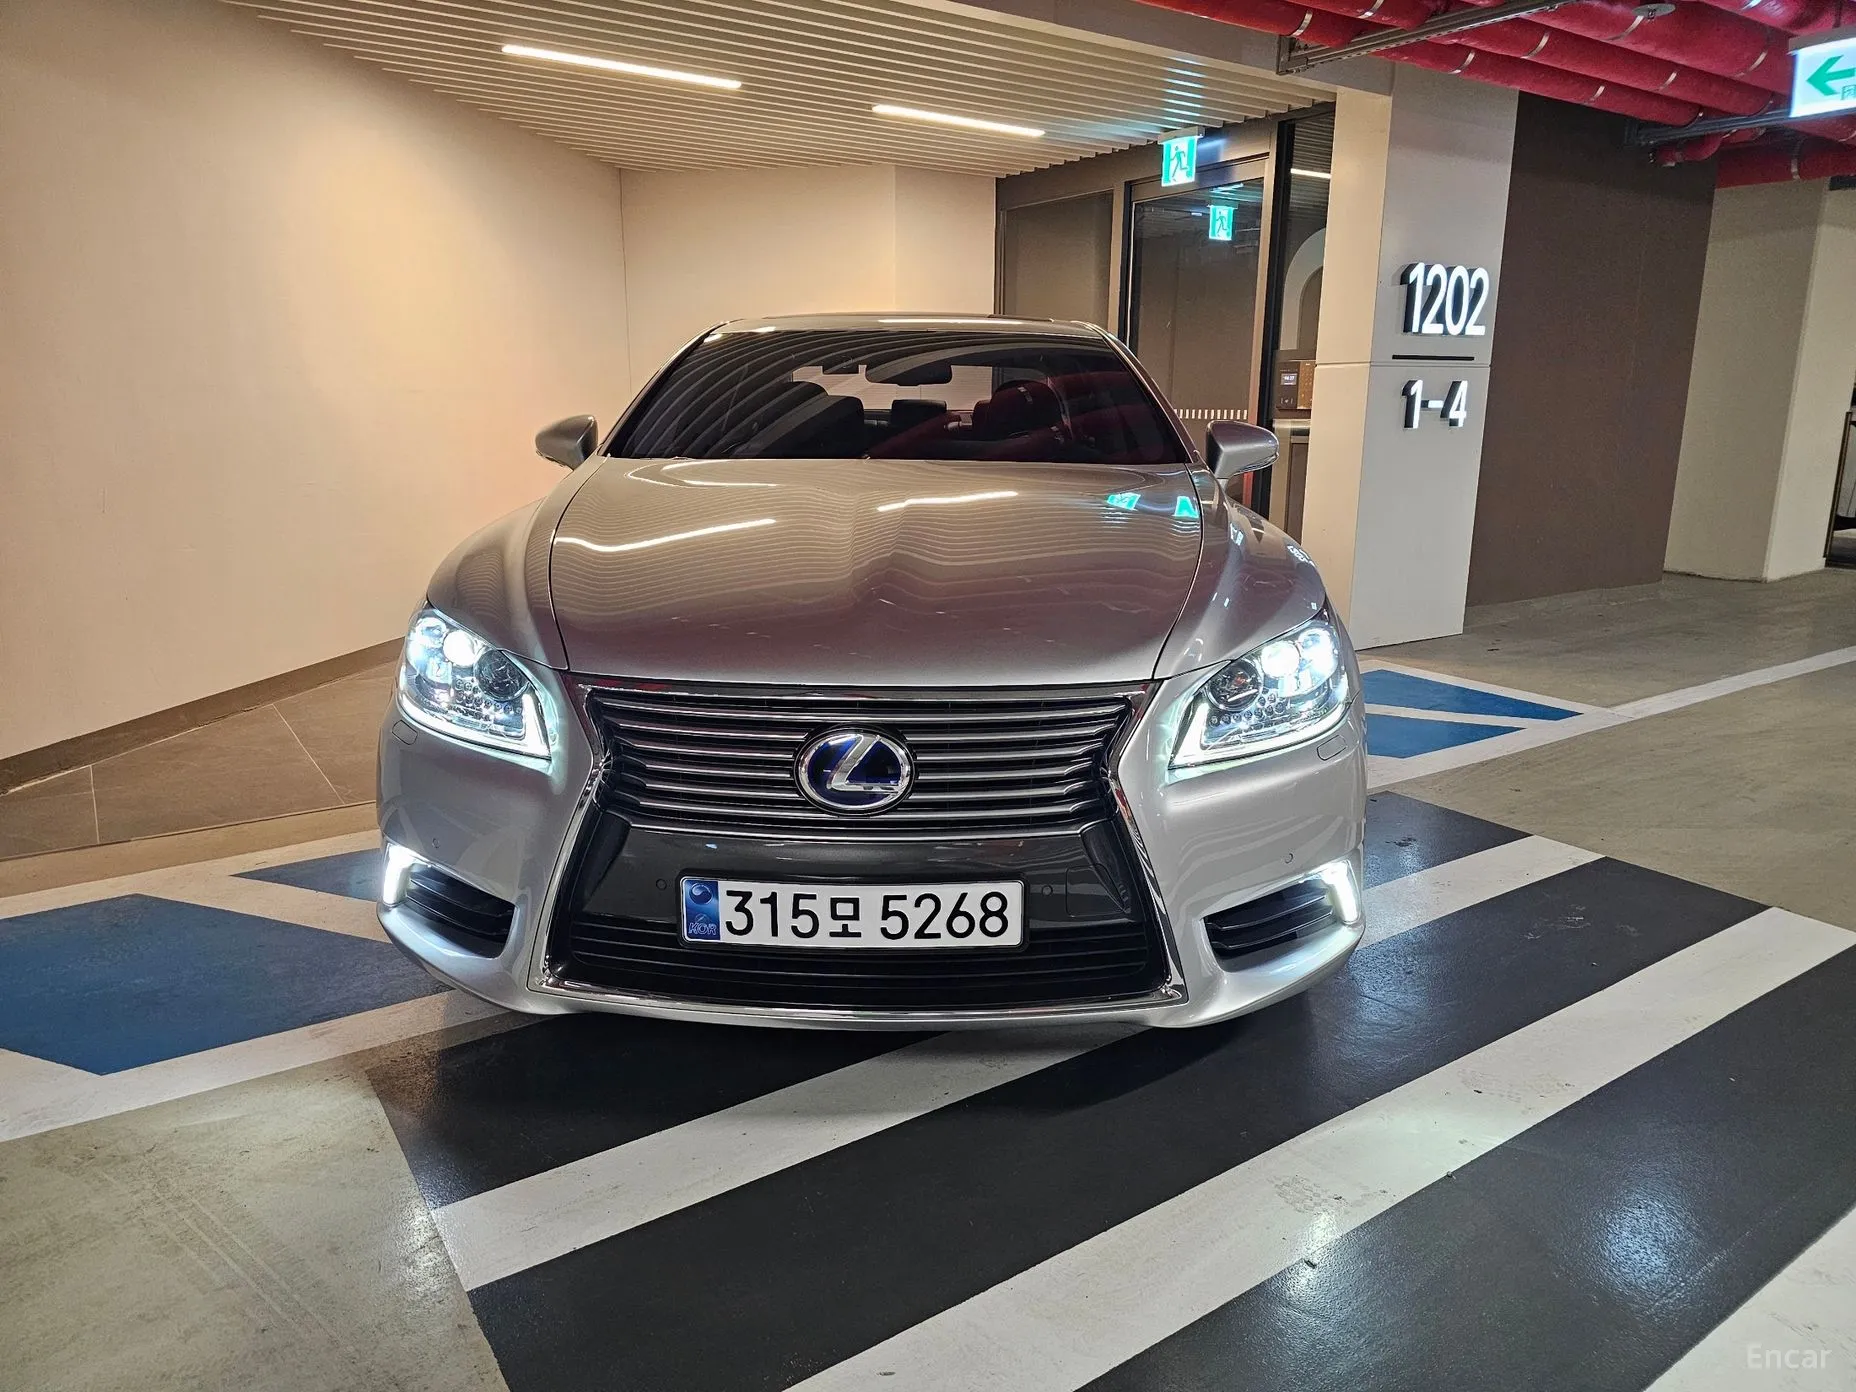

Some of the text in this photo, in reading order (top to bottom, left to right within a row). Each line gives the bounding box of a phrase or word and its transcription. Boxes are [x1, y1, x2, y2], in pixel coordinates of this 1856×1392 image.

[1407, 262, 1490, 336] 1202
[1408, 379, 1469, 429] 1-4
[688, 922, 717, 936] KOR
[725, 890, 1009, 940] 315모 5268
